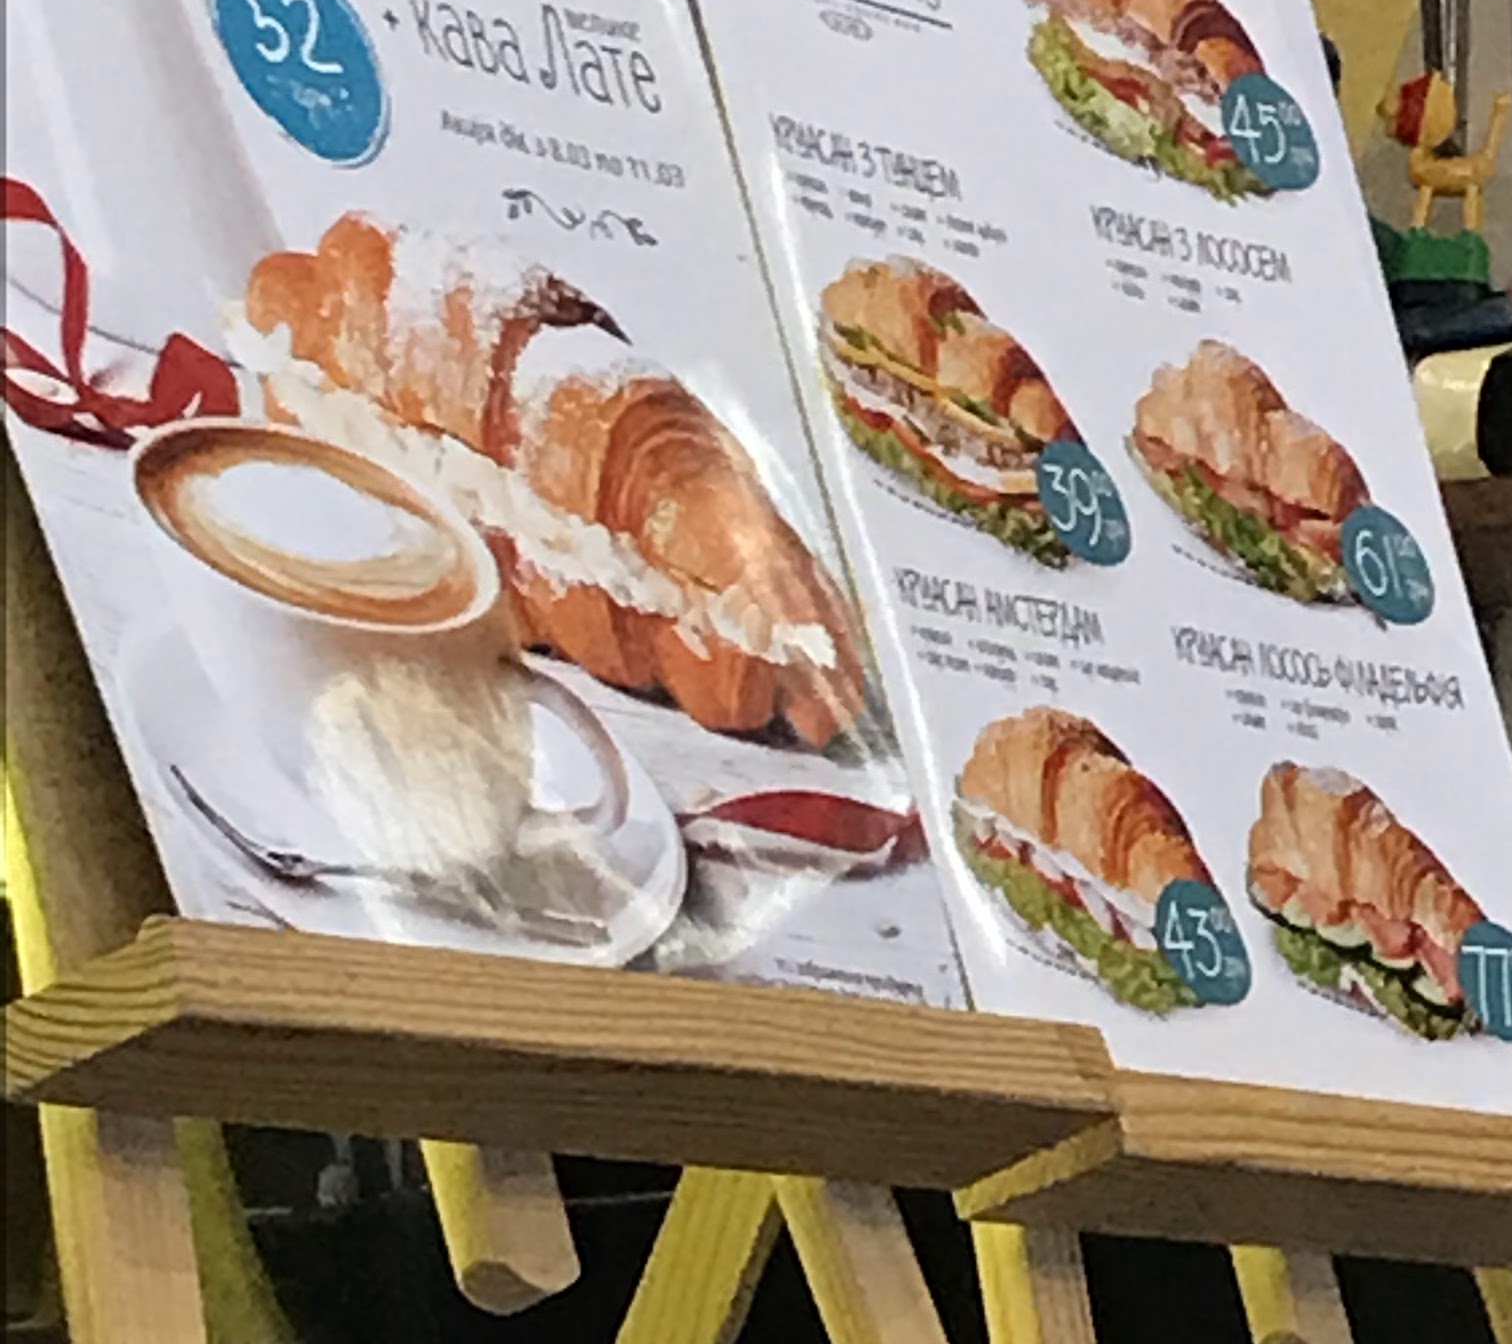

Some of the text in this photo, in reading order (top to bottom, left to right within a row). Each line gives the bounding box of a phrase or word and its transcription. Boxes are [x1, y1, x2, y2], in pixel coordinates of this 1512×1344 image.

[538, 3, 662, 114] Лате
[1229, 93, 1287, 165] 45
[1042, 463, 1103, 547] 39
[1163, 901, 1223, 978] 43
